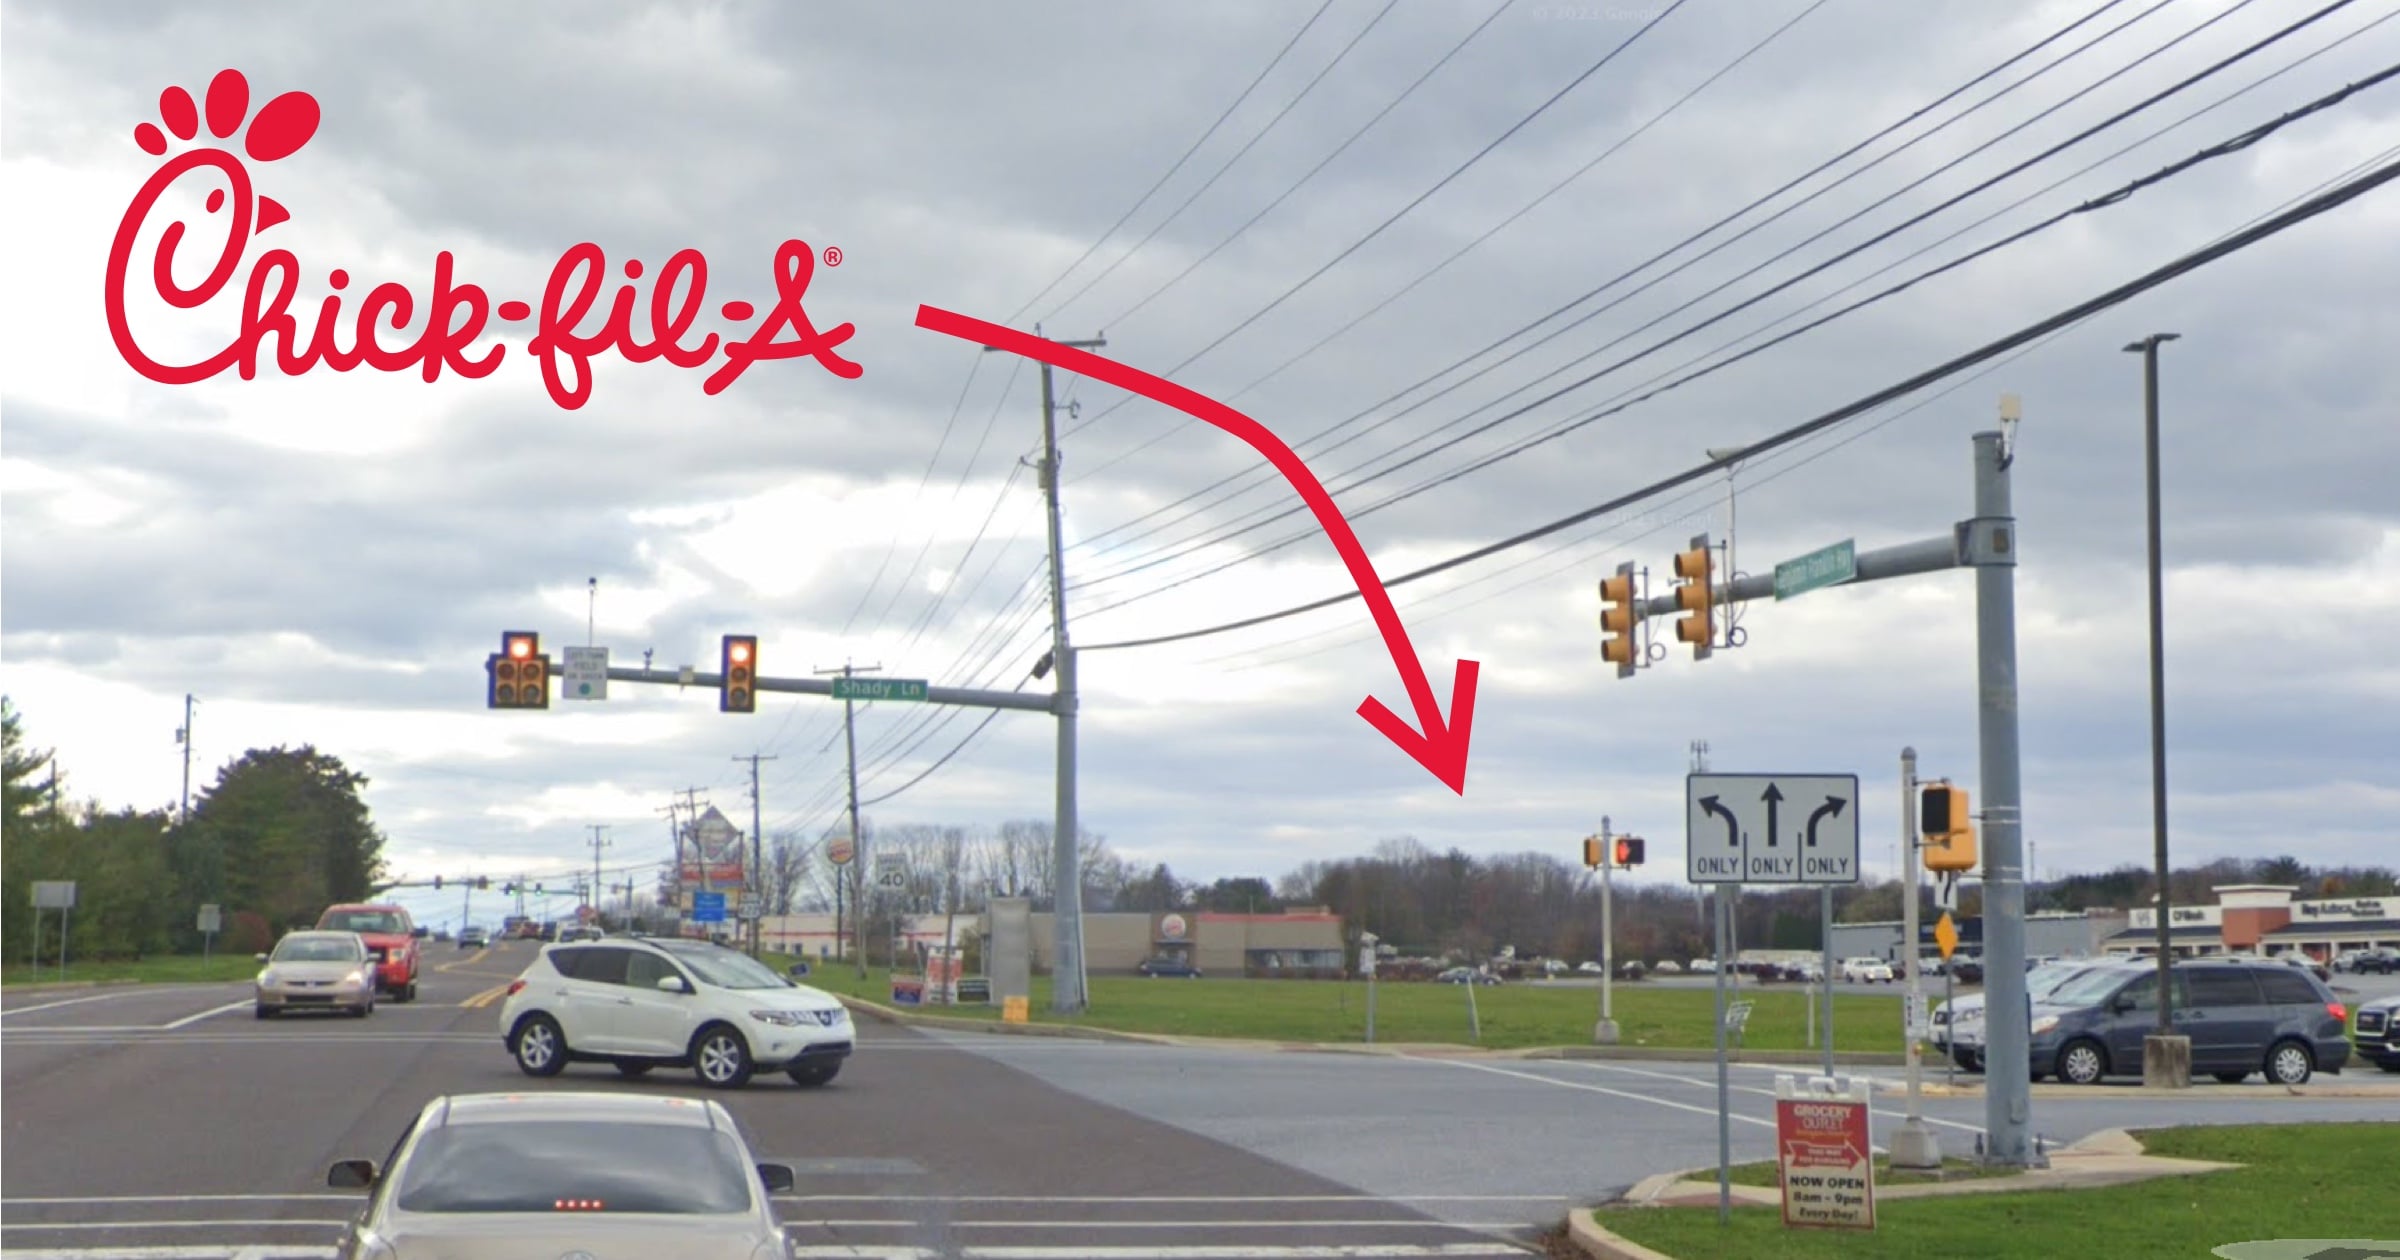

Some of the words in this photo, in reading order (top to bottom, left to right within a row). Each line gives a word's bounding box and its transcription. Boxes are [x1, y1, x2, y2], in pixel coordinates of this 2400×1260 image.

[841, 679, 892, 699] Shady
[901, 682, 920, 697] Ln
[1698, 857, 1739, 875] ONLY
[1752, 857, 1794, 875] ONLY
[1807, 857, 1848, 875] ONLY
[880, 873, 904, 887] 40
[1793, 1104, 1852, 1119] GROCERY
[1802, 1117, 1843, 1130] OUTLET
[1789, 1175, 1824, 1188] NOW
[1828, 1177, 1865, 1190] OPEN
[1793, 1191, 1822, 1204] 8am
[1834, 1193, 1863, 1206] 9pm
[1799, 1207, 1829, 1220] Every
[1832, 1208, 1859, 1222] Day!
